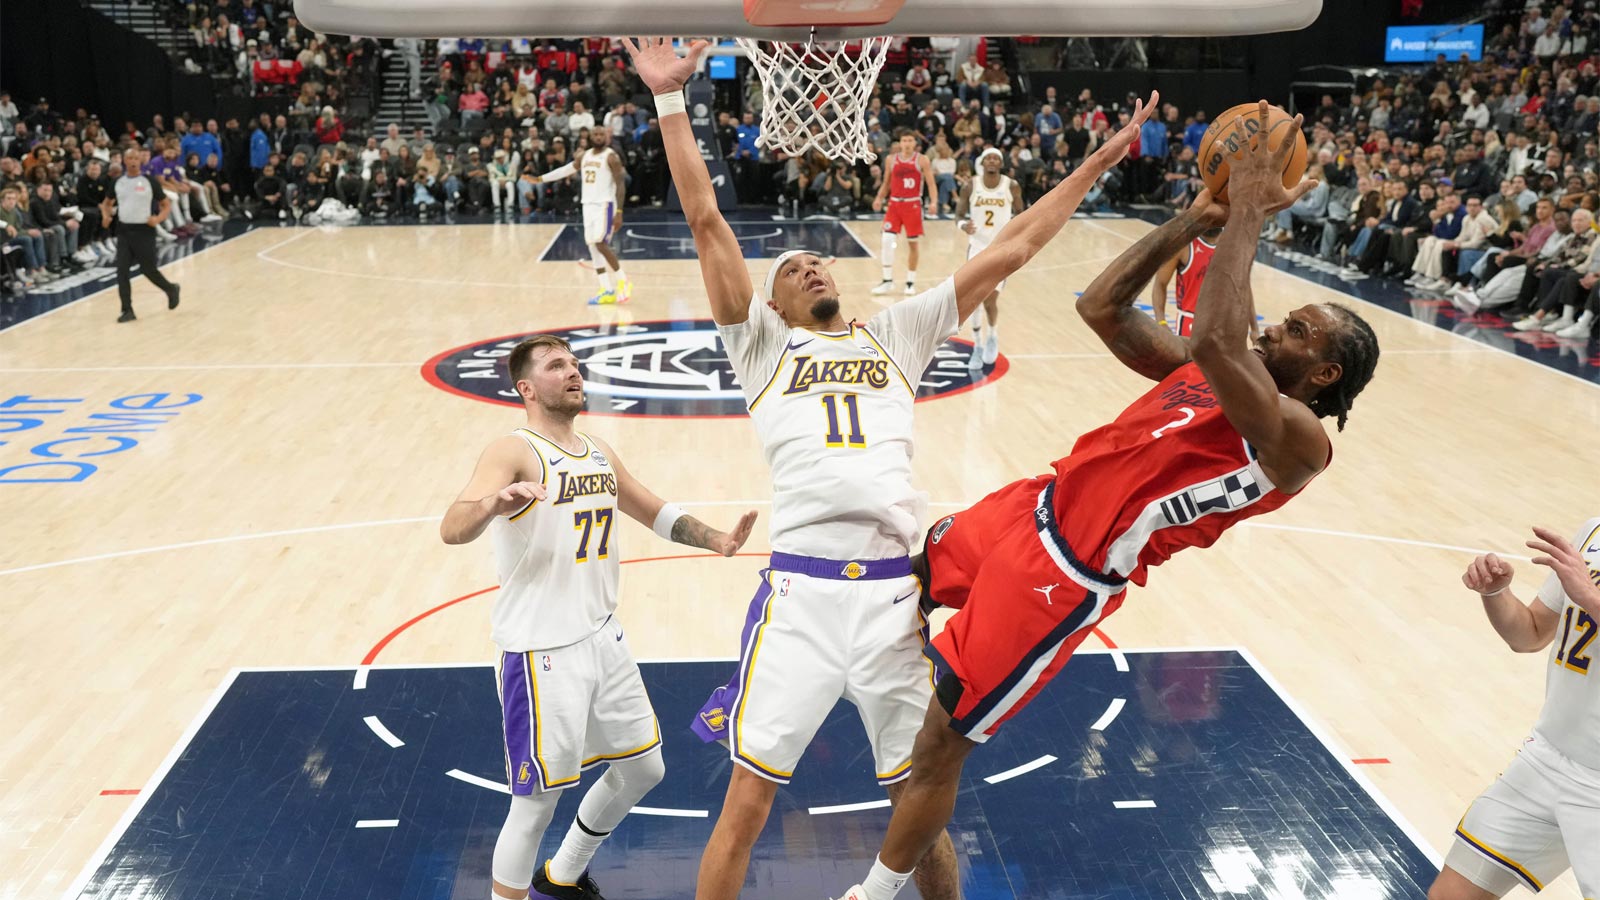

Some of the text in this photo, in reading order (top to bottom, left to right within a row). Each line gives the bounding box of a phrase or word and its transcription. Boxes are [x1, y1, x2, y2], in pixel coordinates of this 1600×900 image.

[585, 170, 596, 184] 23
[903, 178, 916, 189] 10
[984, 210, 995, 227] 2
[782, 355, 889, 395] LAKERS
[821, 393, 867, 449] 11
[1151, 406, 1196, 439] 2
[552, 470, 617, 506] LAKERS
[573, 506, 614, 564] 77
[1554, 604, 1599, 676] 12
